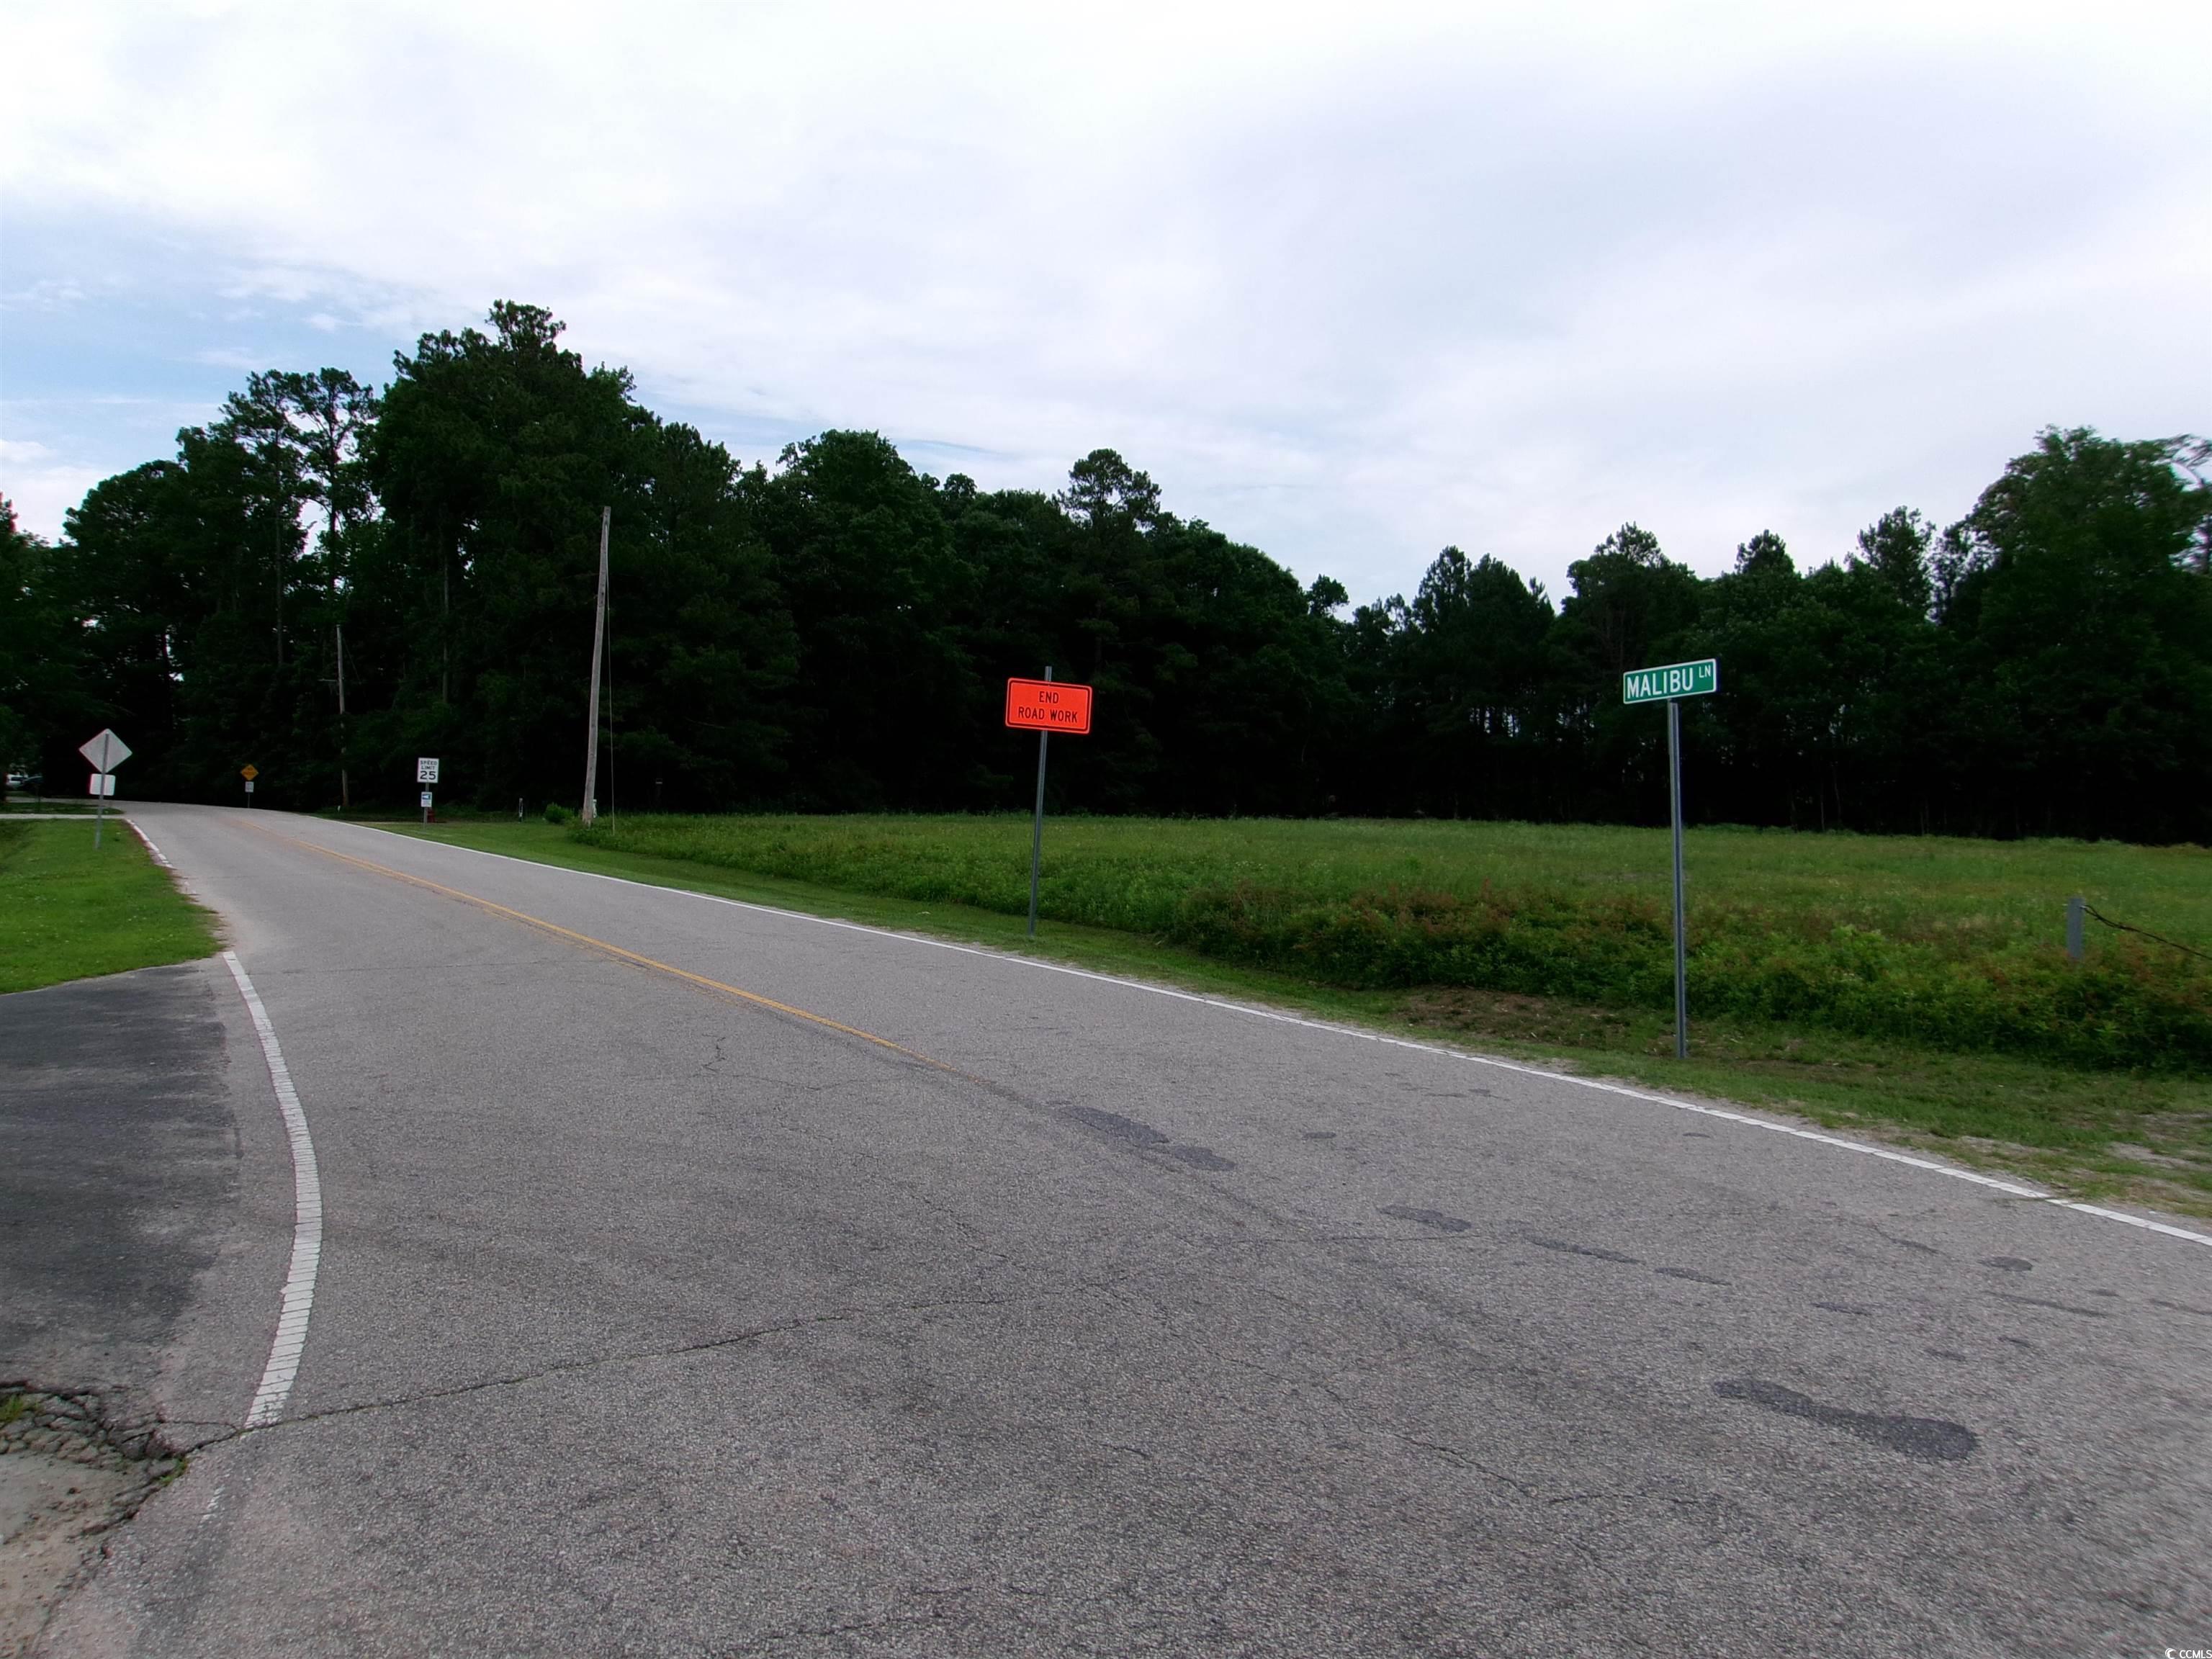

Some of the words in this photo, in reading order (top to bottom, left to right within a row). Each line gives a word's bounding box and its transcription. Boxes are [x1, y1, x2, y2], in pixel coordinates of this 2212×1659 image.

[1627, 667, 1694, 698] MALIBU
[1699, 665, 1711, 678] LN
[1039, 691, 1059, 703] END
[1018, 706, 1045, 719] ROAD
[1050, 709, 1077, 723] WORK
[420, 770, 436, 780] 25
